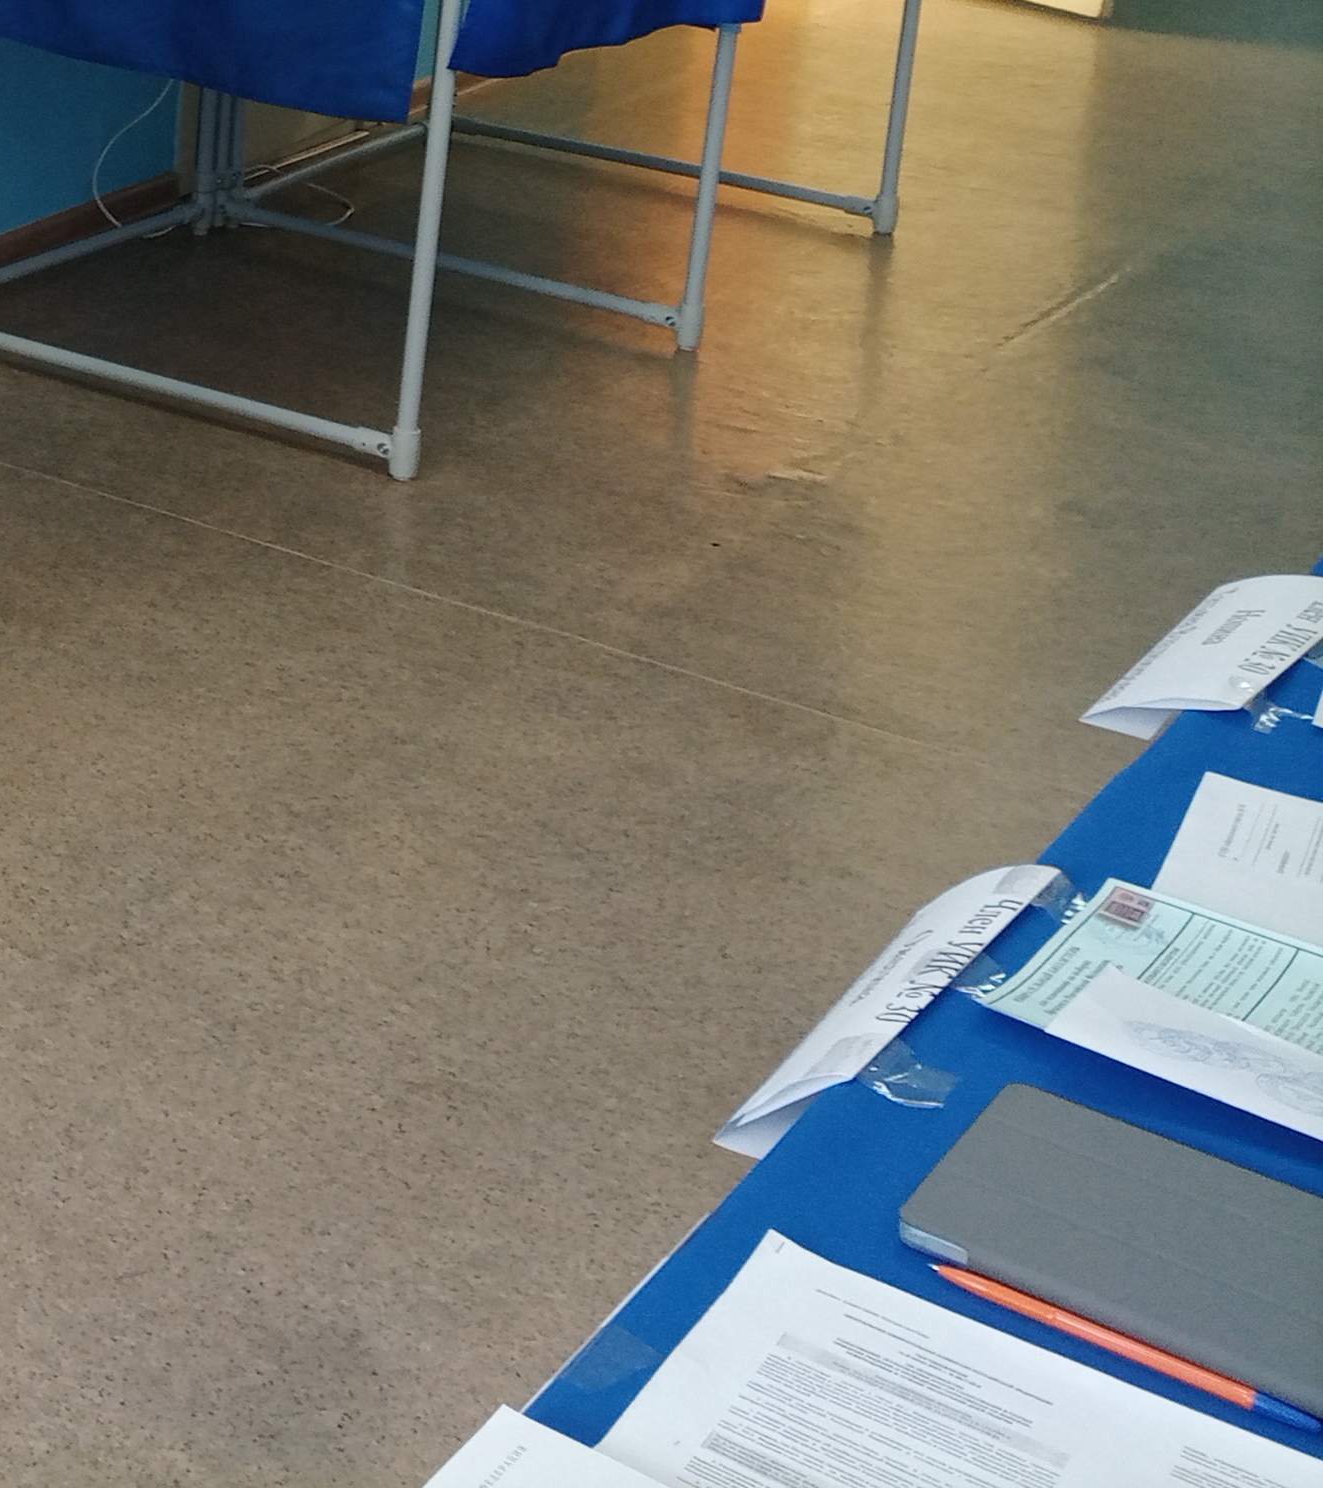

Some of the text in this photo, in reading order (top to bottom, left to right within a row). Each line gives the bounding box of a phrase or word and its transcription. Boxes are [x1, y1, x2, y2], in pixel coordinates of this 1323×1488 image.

[1297, 601, 1323, 624] лен
[959, 899, 1023, 934] Член
[918, 941, 985, 980] УИК
[896, 980, 947, 999] №
[875, 1003, 921, 1024] 30
